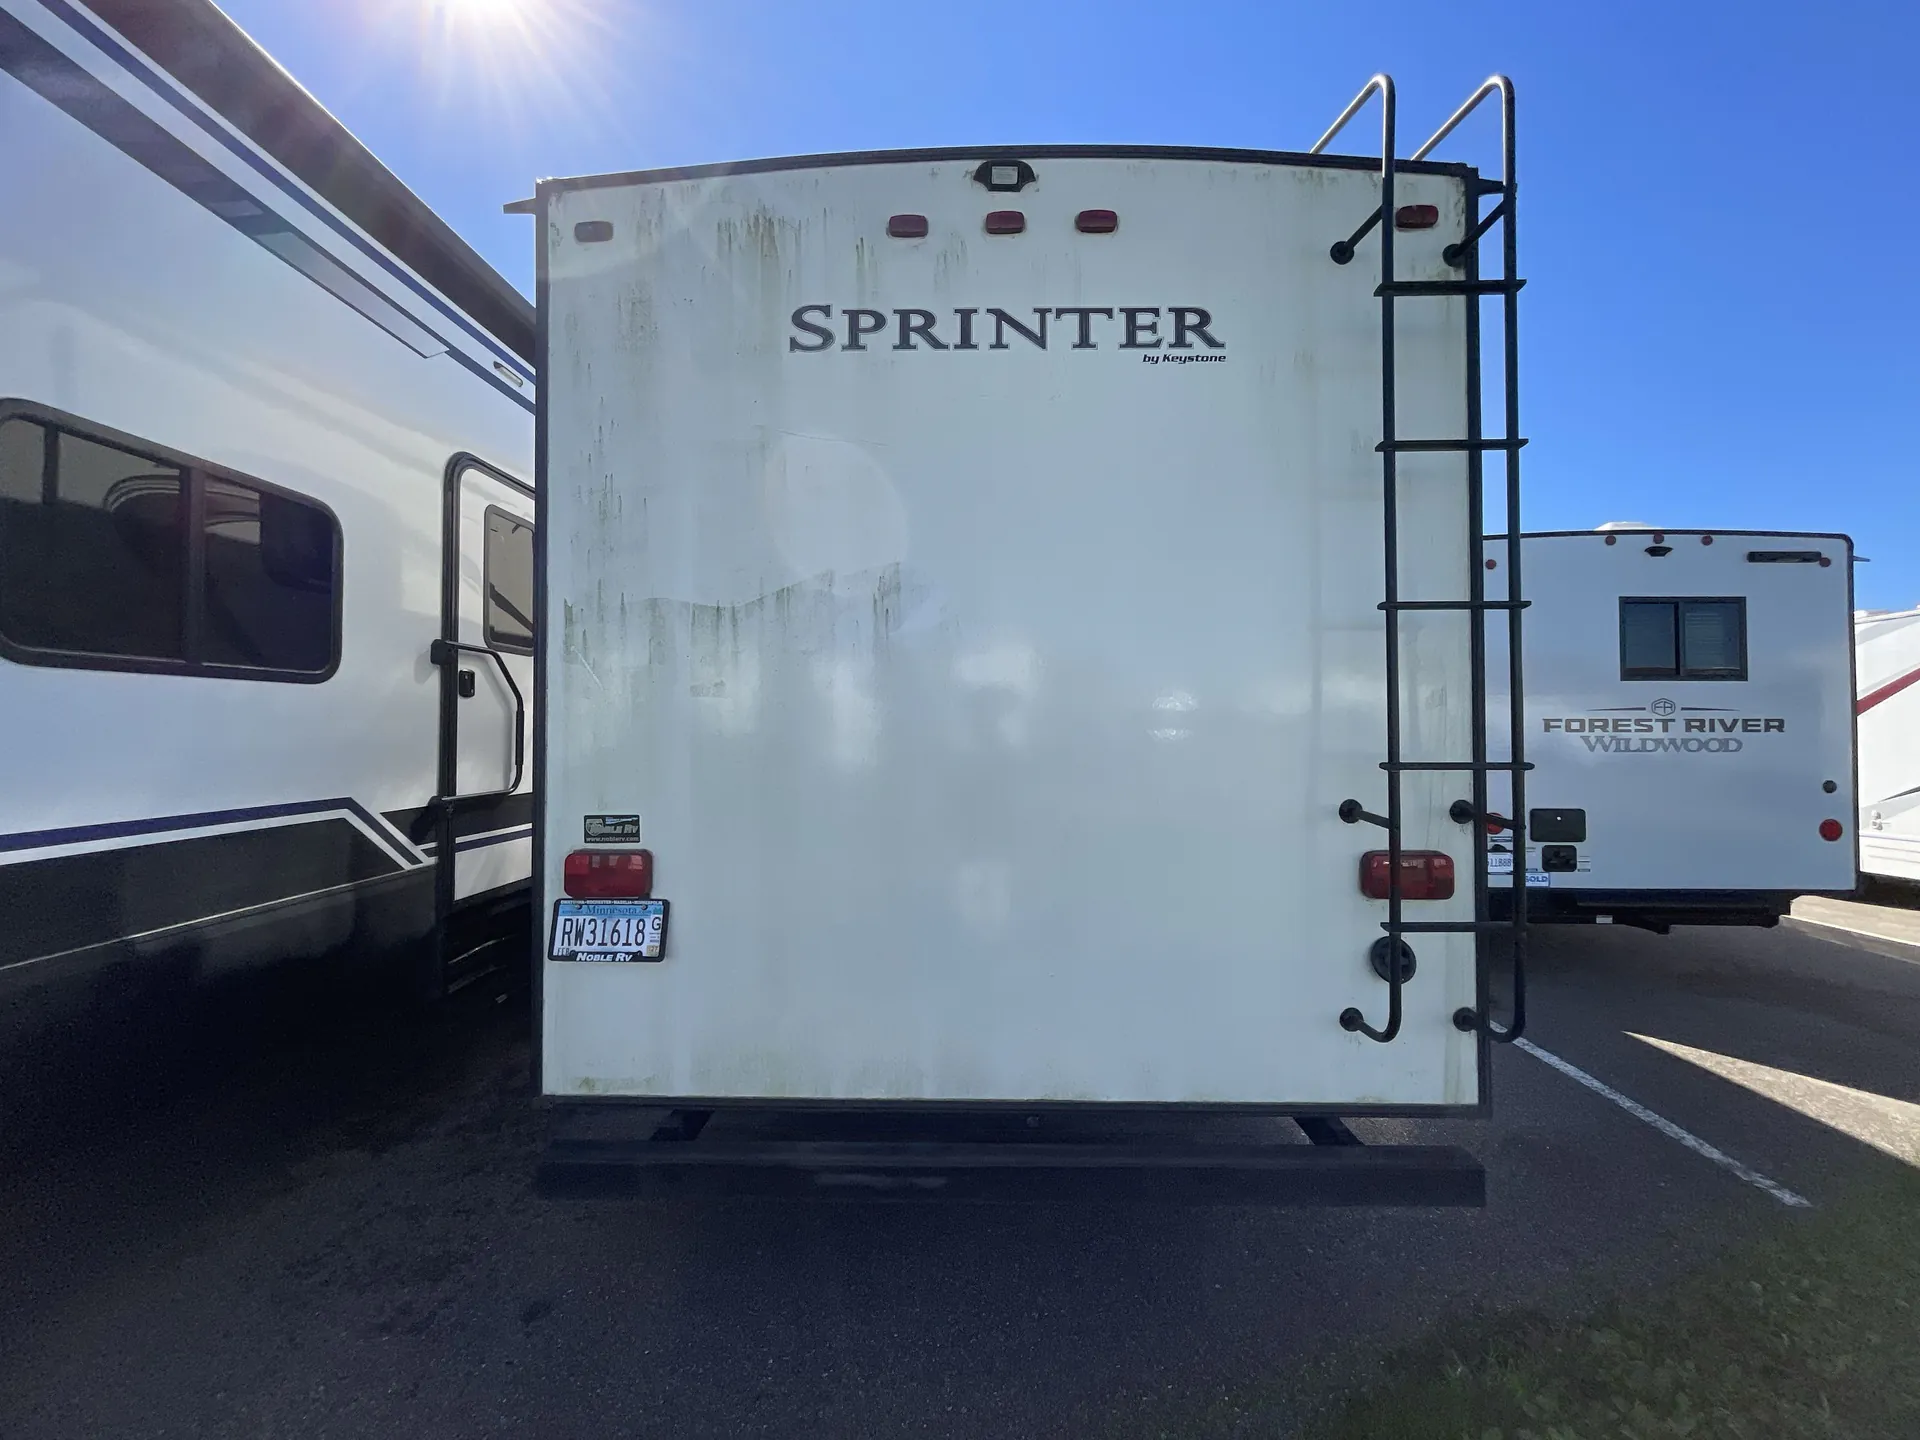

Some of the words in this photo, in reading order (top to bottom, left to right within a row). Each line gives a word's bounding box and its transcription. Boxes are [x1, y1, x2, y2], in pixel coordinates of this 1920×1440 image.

[789, 303, 1227, 352] SPRINTER
[1143, 354, 1159, 364] by
[1162, 354, 1226, 364] Keystone
[1543, 718, 1676, 733] FOREST
[1684, 718, 1785, 733] RIVER
[1580, 735, 1743, 753] WILDWOOD
[1525, 875, 1549, 883] SOLD
[586, 905, 637, 914] Minnesota
[651, 917, 661, 931] G
[561, 918, 646, 946] RW31618
[576, 953, 613, 961] NOBLE
[615, 952, 633, 961] RV
